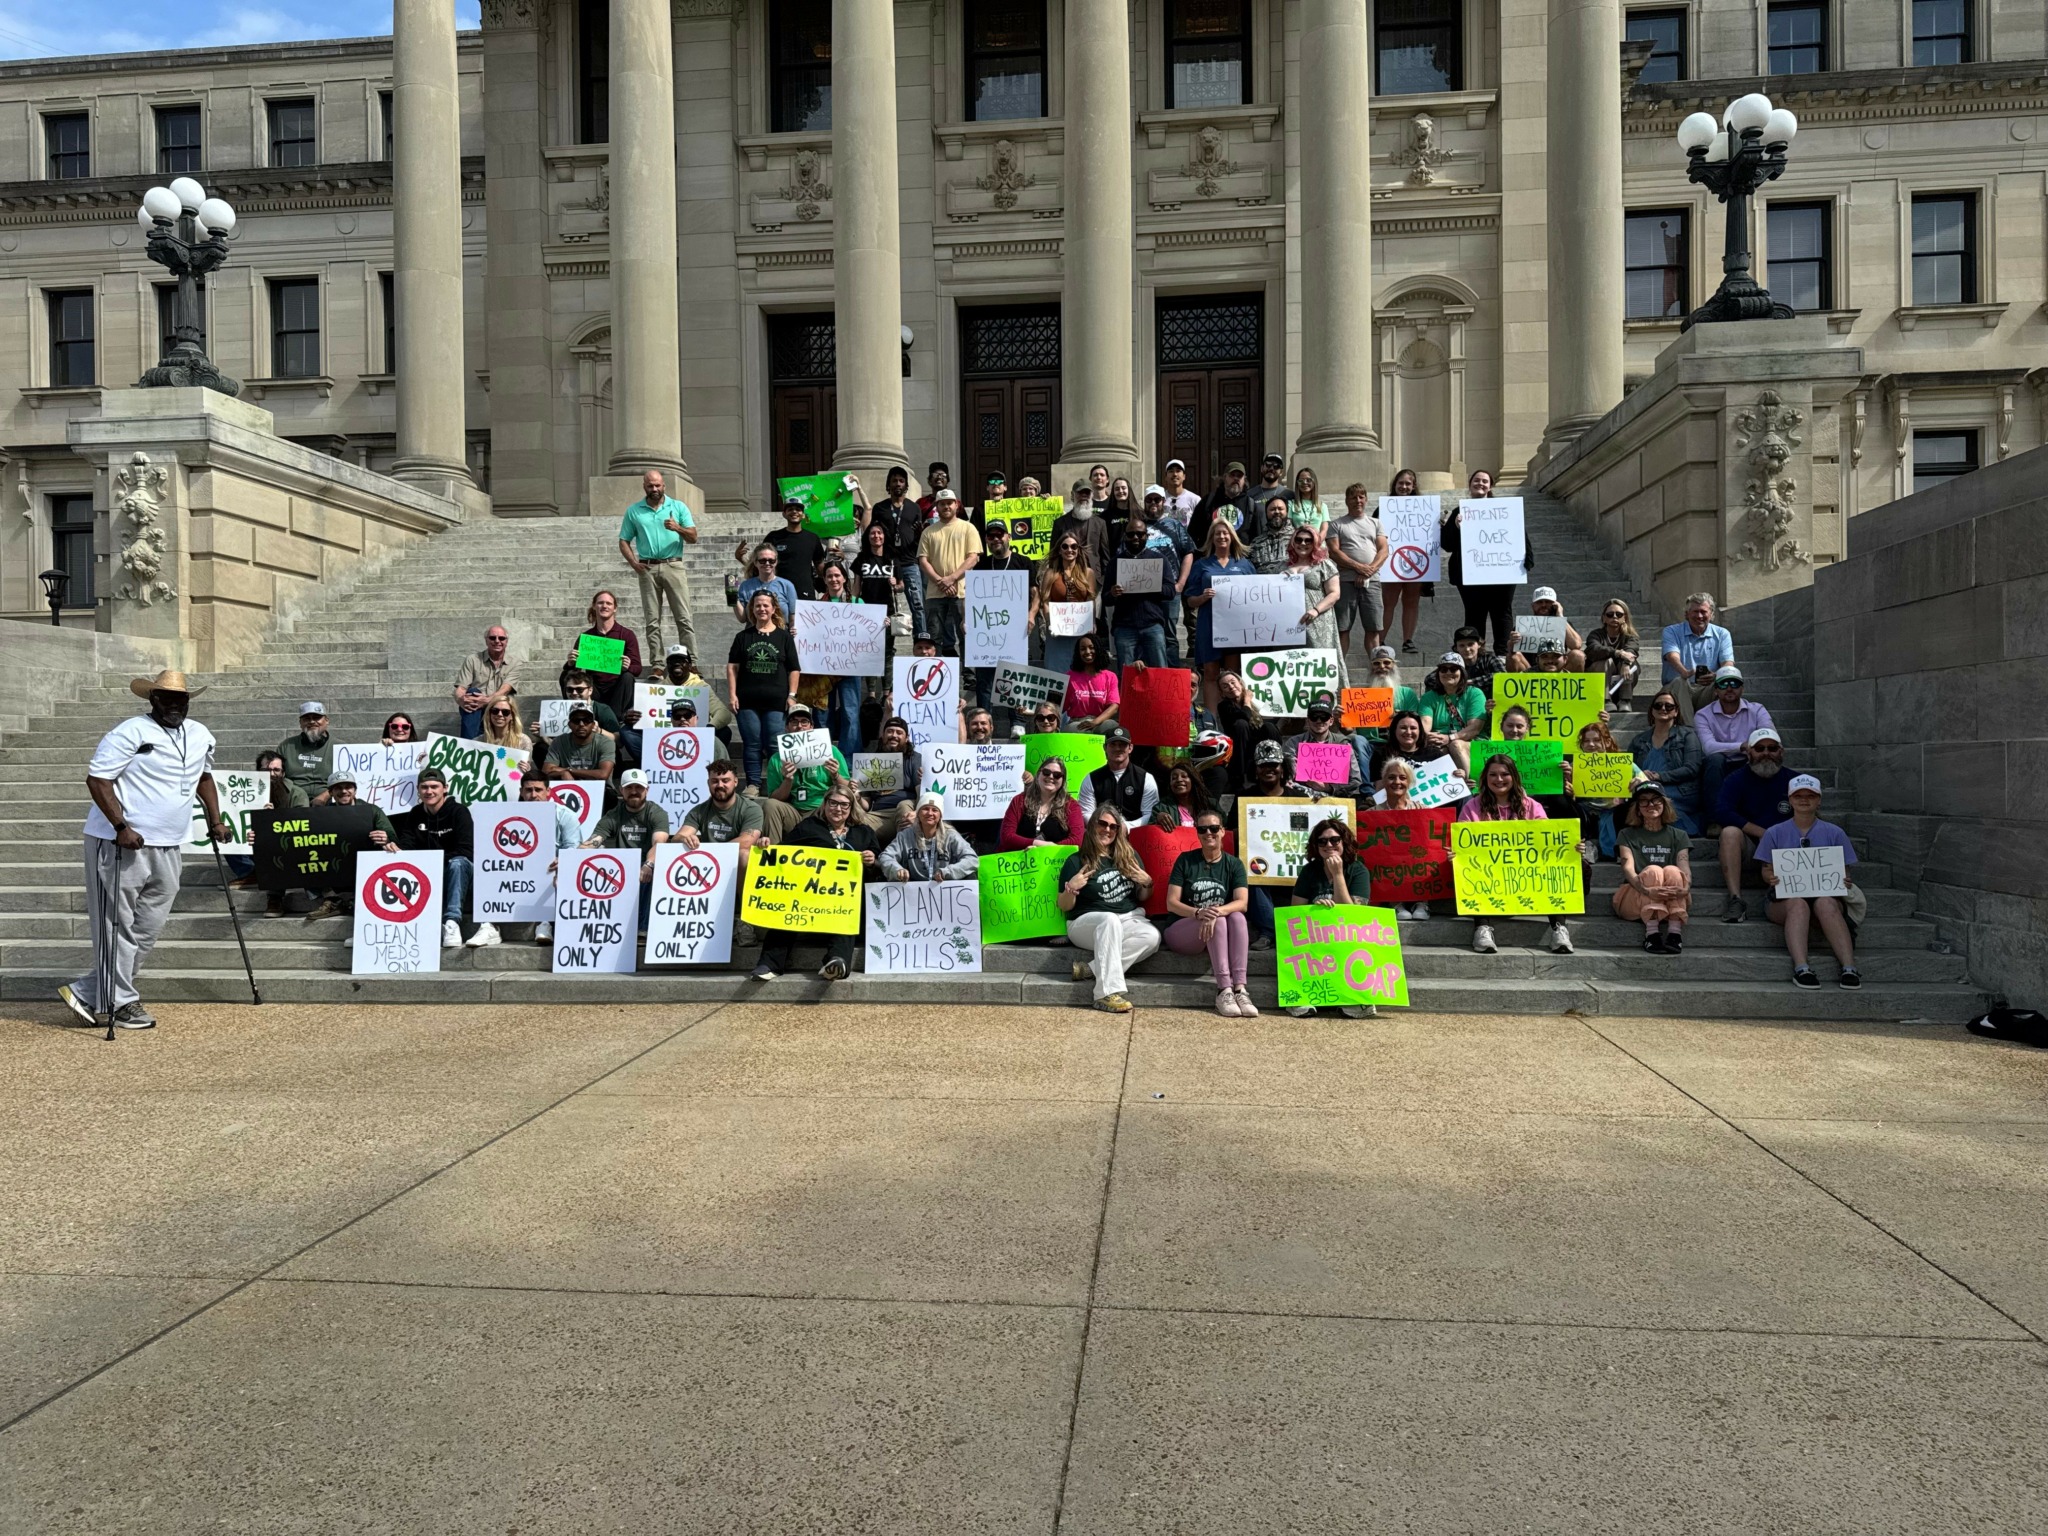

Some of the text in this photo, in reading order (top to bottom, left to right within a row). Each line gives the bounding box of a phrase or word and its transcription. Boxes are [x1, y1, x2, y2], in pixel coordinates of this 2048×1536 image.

[1387, 498, 1433, 513] CLEAN
[1462, 507, 1509, 521] PATIENTS
[1396, 514, 1432, 527] MEDS
[1390, 527, 1431, 542] ONLY
[1479, 530, 1512, 545] OVER
[1467, 549, 1512, 563] POLITICS
[973, 575, 1023, 601] CLEAN
[1229, 584, 1286, 608] RIGHT
[799, 605, 825, 629] Not
[831, 606, 840, 619] a
[972, 605, 1011, 630] MEDS
[1248, 611, 1266, 625] TO
[1518, 617, 1555, 633] SAVE
[823, 624, 857, 639] Just a
[1231, 624, 1276, 644] TRY
[848, 637, 880, 654] Needs
[976, 632, 1006, 650] ONLY
[821, 652, 859, 671] Relief
[1246, 657, 1338, 681] Override
[1002, 669, 1064, 690] PATIENTS
[649, 686, 700, 698] NO CAP
[1013, 685, 1047, 700] OVER
[1248, 682, 1274, 704] the
[1348, 689, 1367, 700] Let
[1504, 678, 1587, 700] OVERRIDE
[999, 695, 1037, 710] POLIT
[1346, 697, 1392, 713] Mississippi
[1526, 701, 1553, 715] THE
[898, 701, 946, 726] CLEAN
[1359, 712, 1380, 726] Heal
[1529, 715, 1574, 737] ETO
[782, 731, 816, 749] SAVE
[1481, 743, 1505, 754] Plants
[663, 738, 698, 761] 60%
[784, 743, 831, 764] HB 1152
[1301, 744, 1348, 758] Override
[931, 749, 971, 775] Save
[1311, 759, 1332, 768] the
[1579, 753, 1632, 769] Safe Access
[228, 775, 252, 789] SAVE
[953, 778, 1013, 792] HB895 People
[231, 789, 255, 805] 895
[660, 787, 700, 804] MEDS
[955, 794, 987, 808] HB1152
[273, 820, 310, 833] SAVE
[1429, 820, 1448, 849] 4
[294, 834, 338, 848] RIGHT
[498, 827, 532, 847] 60%
[1260, 830, 1309, 843] CANNA
[1458, 827, 1570, 849] OVERRIDE THE
[309, 851, 318, 861] 2
[759, 848, 789, 867] No
[791, 849, 827, 874] Cap
[1286, 854, 1305, 865] MY
[1489, 848, 1538, 865] VETO
[1780, 848, 1833, 873] SAVE
[298, 862, 329, 874] TRY
[482, 859, 524, 872] CLEAN
[997, 852, 1037, 879] People
[581, 866, 620, 893] 60%
[675, 865, 714, 888] 60%
[755, 875, 797, 891] Better
[1462, 867, 1504, 897] Save
[1502, 866, 1543, 896] HB895
[1783, 872, 1846, 894] HB 1152
[381, 876, 420, 905] 60%
[499, 880, 536, 893] MEDS
[993, 877, 1037, 896] Politics
[1412, 880, 1443, 896] 895
[483, 901, 515, 914] ONLY
[559, 898, 612, 920] CLEAN
[655, 897, 709, 916] CLEAN
[748, 895, 855, 916] Please Reconsider
[881, 885, 973, 926] PLANTS
[989, 894, 1057, 926] Save HB895
[364, 923, 418, 946] CLEAN
[579, 922, 623, 945] MEDS
[673, 921, 715, 939] MEDS
[911, 926, 955, 940] over
[1287, 915, 1398, 947] Eliminate
[374, 944, 420, 965] MEDS
[557, 945, 604, 968] ONLY
[655, 940, 699, 960] ONLY
[886, 942, 955, 971] PILLS
[388, 960, 421, 973] ONLY
[1284, 952, 1338, 981] The
[1302, 978, 1334, 993] SAVE
[1308, 990, 1339, 1006] 895
